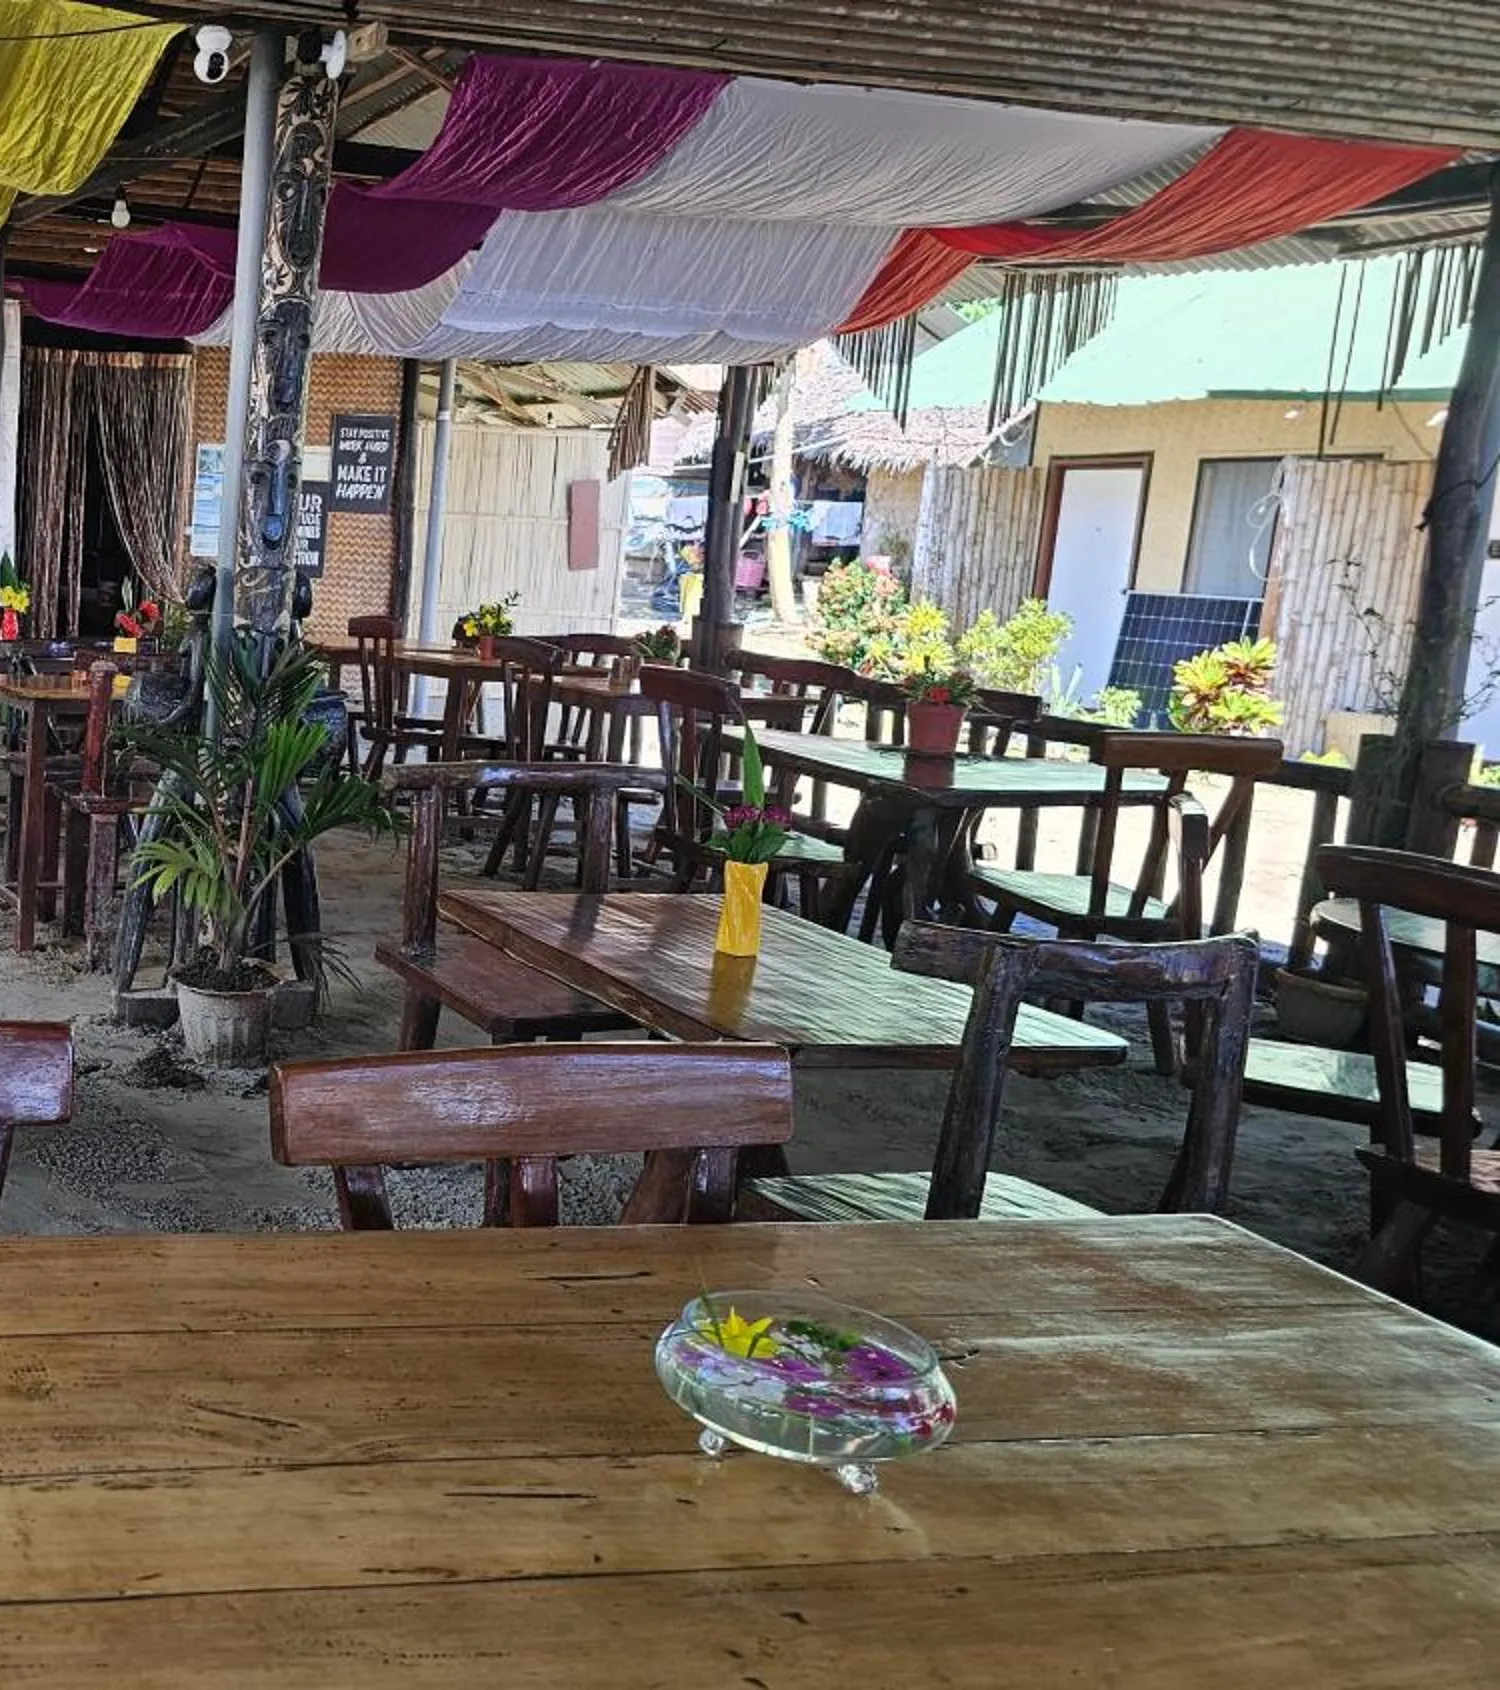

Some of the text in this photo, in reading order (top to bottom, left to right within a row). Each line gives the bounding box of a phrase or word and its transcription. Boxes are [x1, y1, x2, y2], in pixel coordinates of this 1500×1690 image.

[337, 464, 387, 482] MAKE IT
[335, 483, 387, 500] HAPPEN
